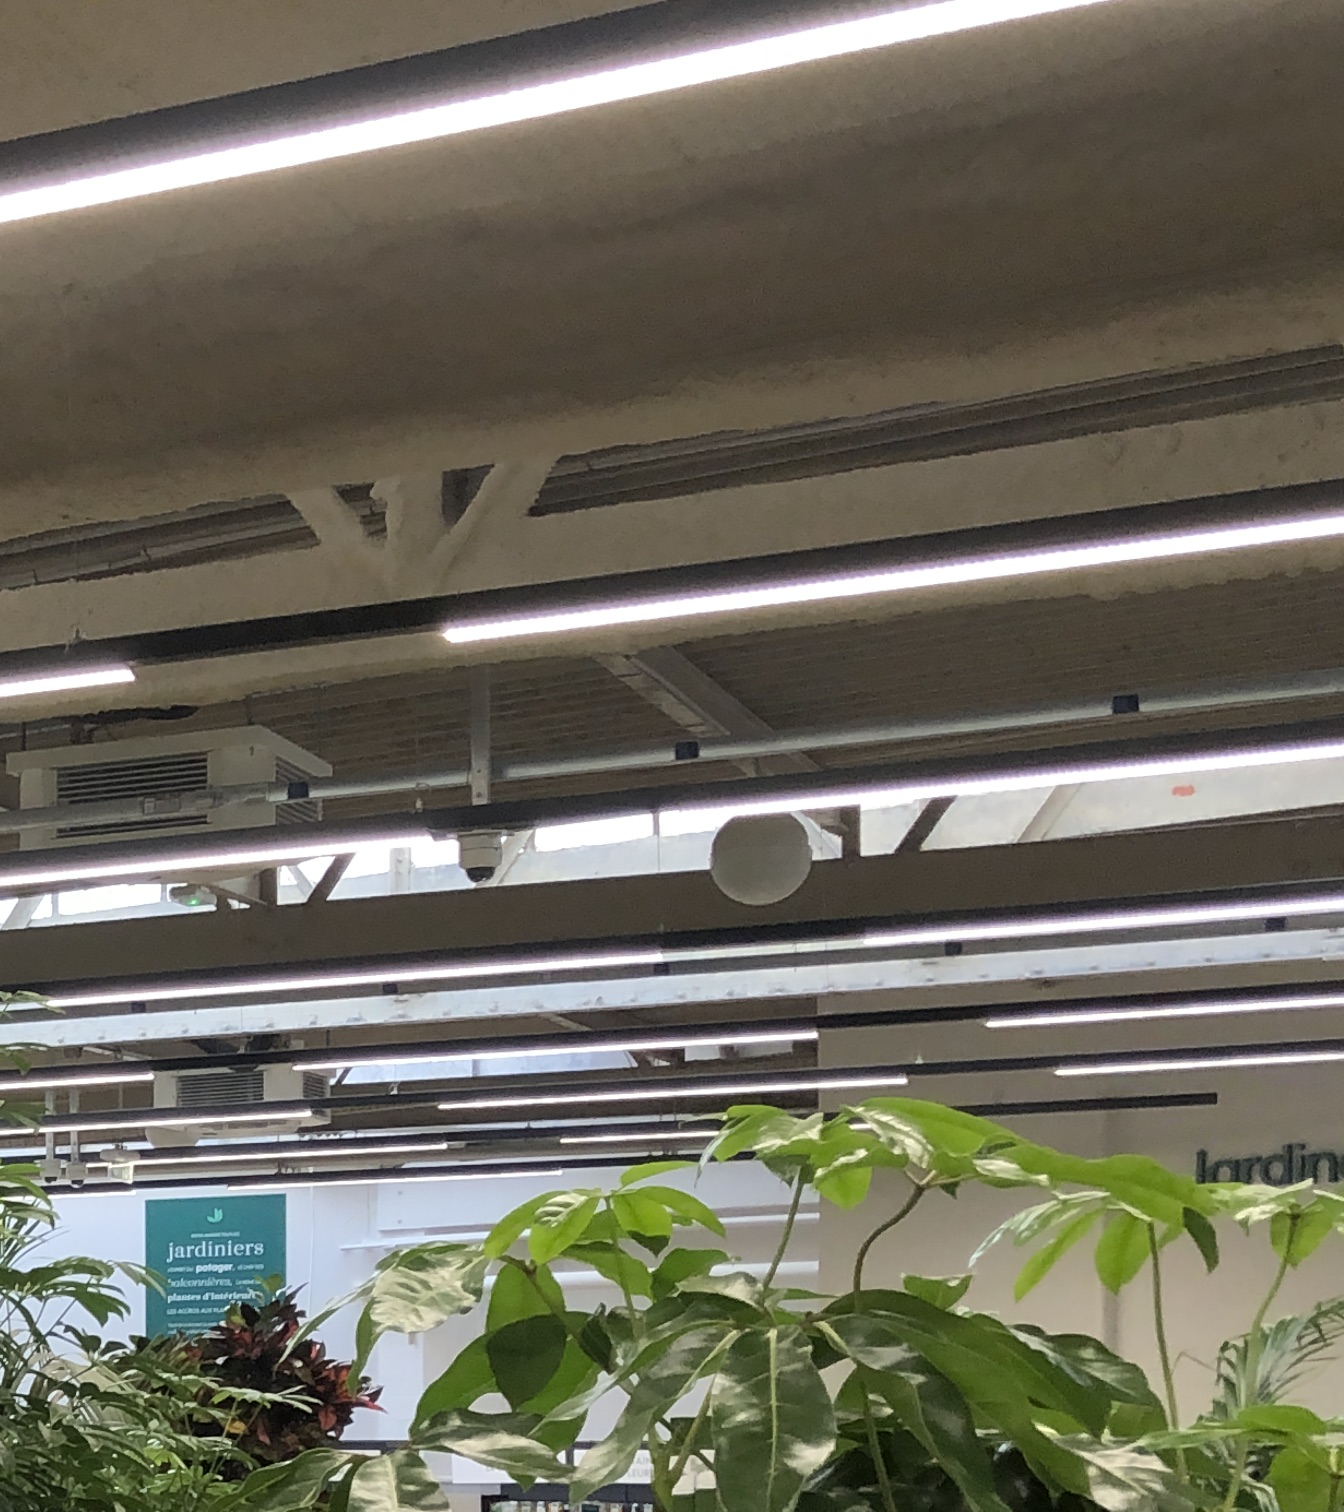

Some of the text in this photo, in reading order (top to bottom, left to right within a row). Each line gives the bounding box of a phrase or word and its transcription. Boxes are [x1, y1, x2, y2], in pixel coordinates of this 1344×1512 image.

[1196, 1143, 1344, 1186] Jardin
[166, 1240, 265, 1263] jardiniers
[627, 1468, 655, 1478] LEUR
